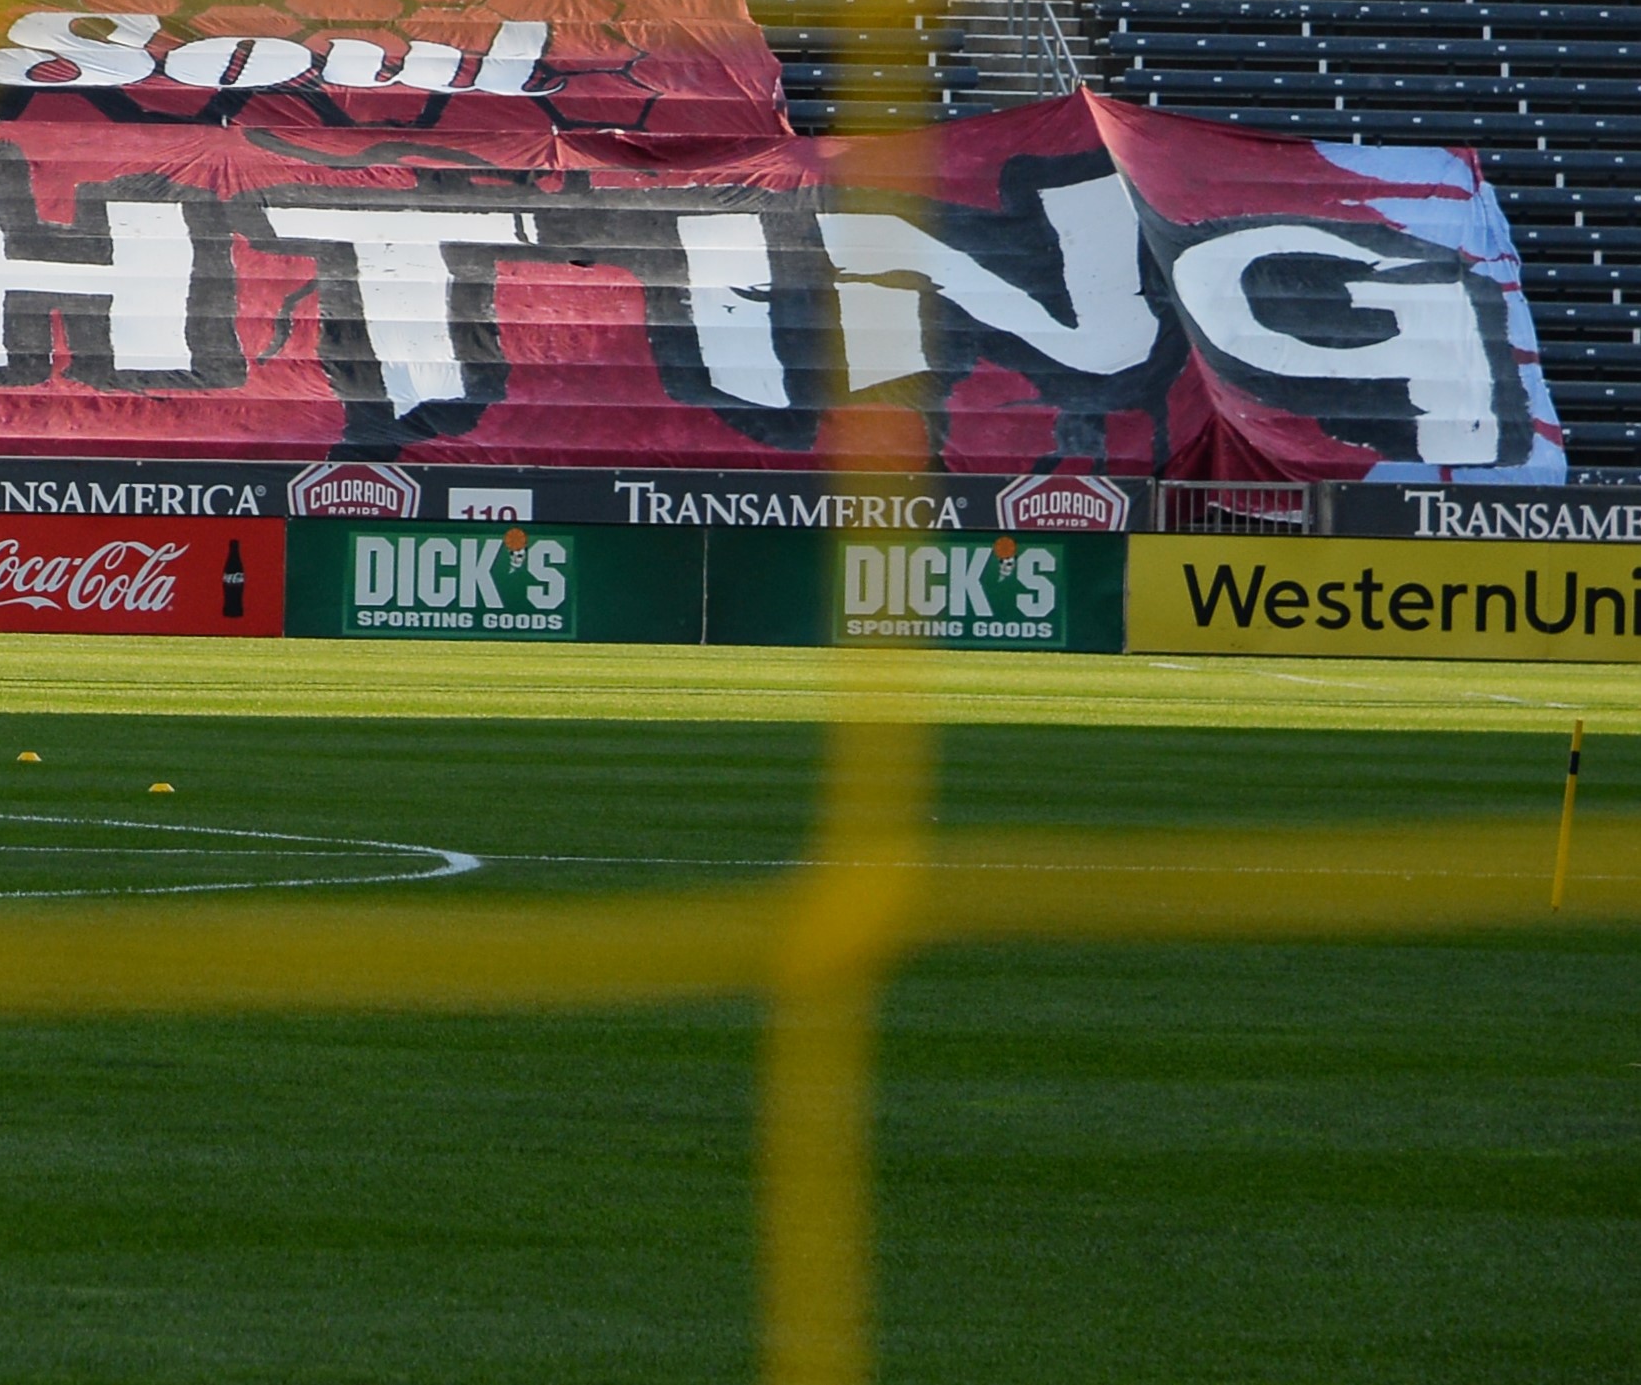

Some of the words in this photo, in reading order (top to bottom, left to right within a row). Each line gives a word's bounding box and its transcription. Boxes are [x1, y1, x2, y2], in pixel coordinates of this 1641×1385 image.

[309, 479, 398, 512] COLORADO
[1018, 490, 1107, 523] COLORADO
[328, 506, 380, 515] RAPIDS
[1036, 517, 1090, 527] RAPIDS
[354, 535, 568, 611] DICK'S
[844, 544, 1057, 618] DICK'S
[356, 611, 474, 630] SPORTING
[481, 612, 564, 631] GOODS
[847, 619, 964, 637] SPORTING
[972, 620, 1054, 638] GOODS
